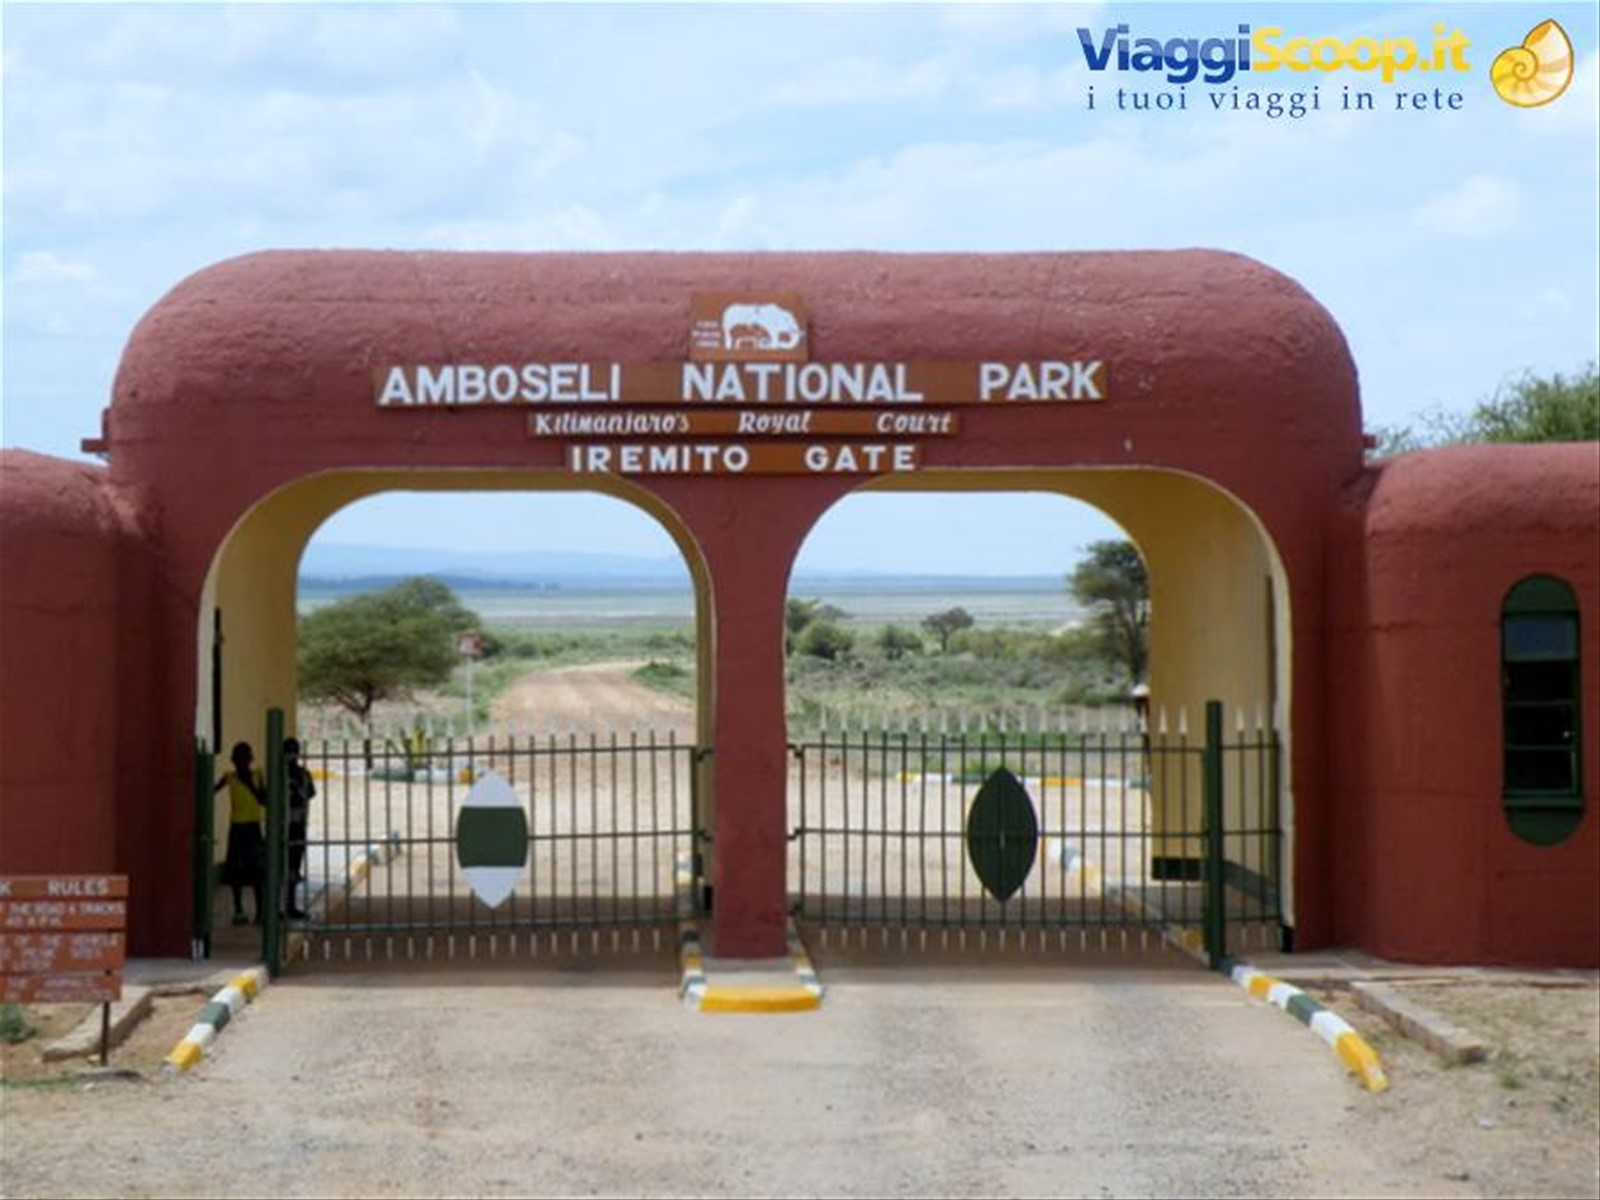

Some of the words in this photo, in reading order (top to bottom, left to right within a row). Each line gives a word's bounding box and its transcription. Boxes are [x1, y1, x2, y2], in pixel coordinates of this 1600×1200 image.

[378, 363, 621, 405] AMBOSELI
[682, 361, 924, 403] NATIONAL
[979, 361, 1104, 401] PARK
[534, 411, 691, 435] Kilimanjaro's
[737, 410, 812, 435] Royal
[876, 411, 952, 434] Court
[571, 444, 750, 474] IREMITO
[804, 444, 917, 473] GATE
[47, 878, 109, 897] RULES
